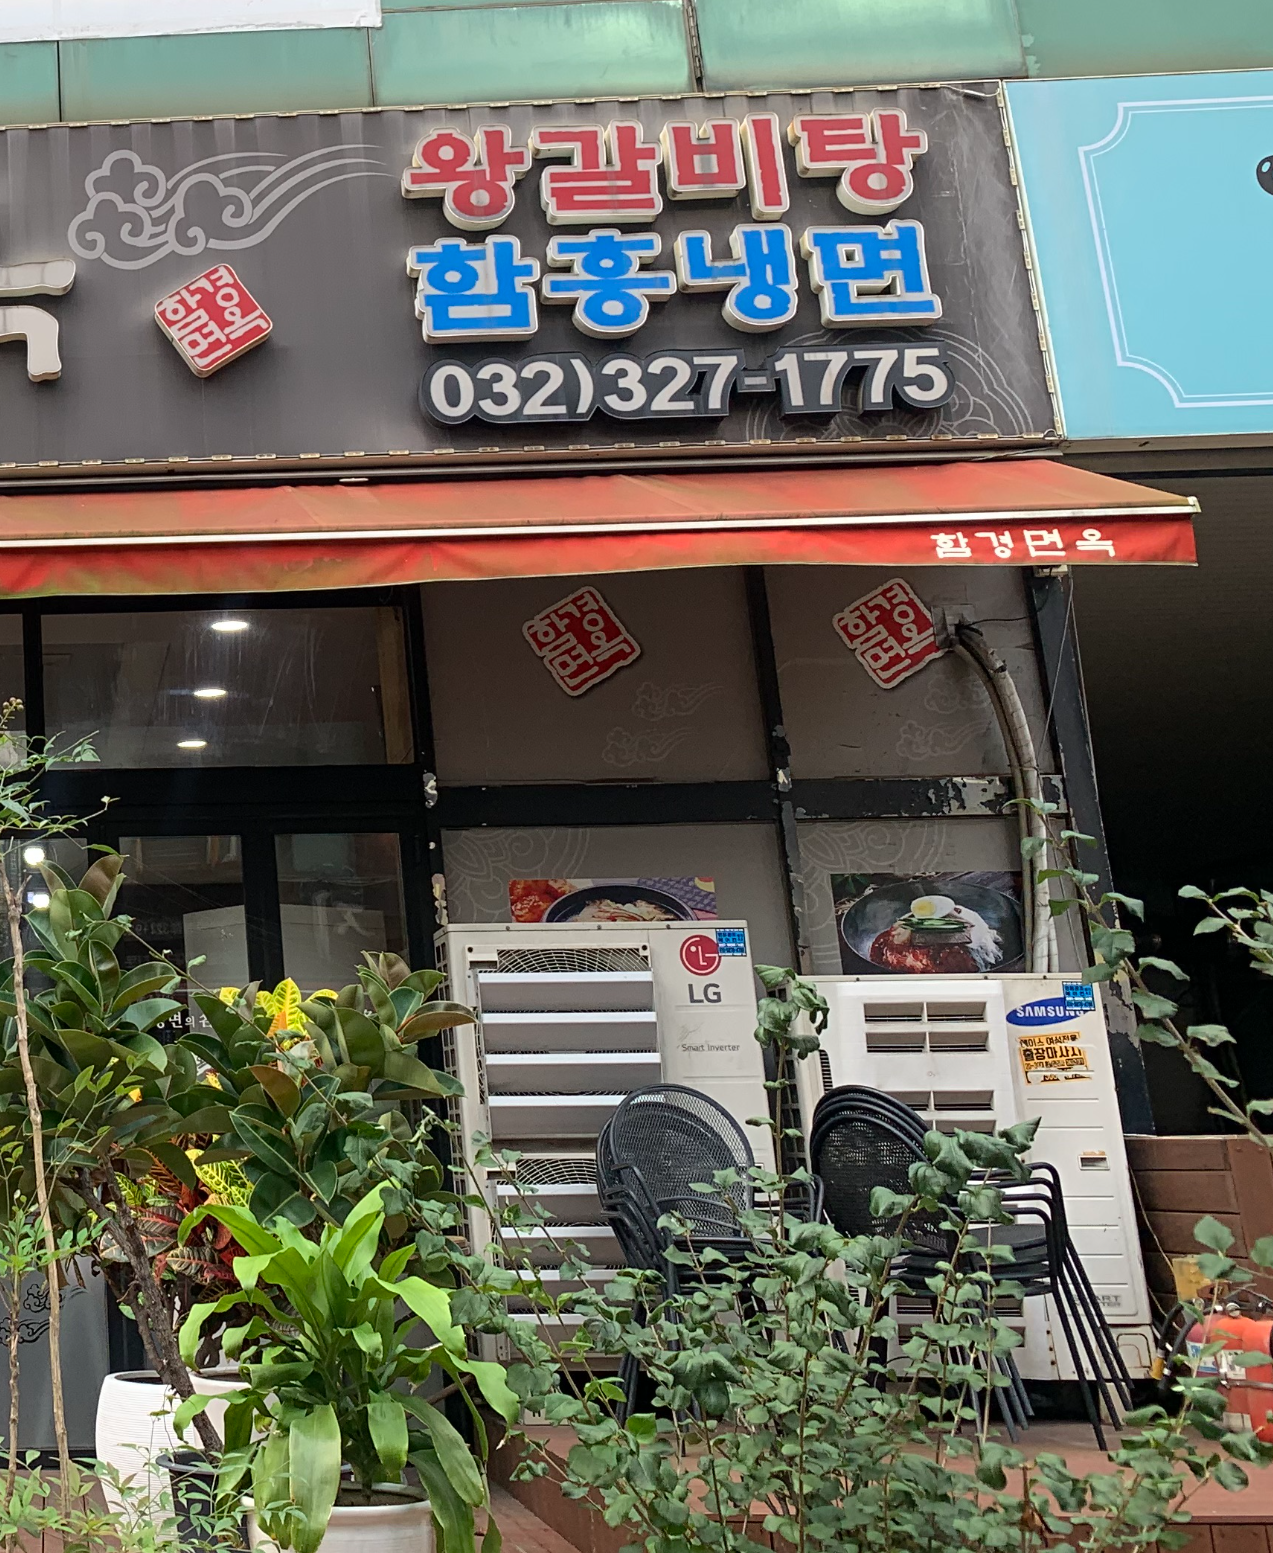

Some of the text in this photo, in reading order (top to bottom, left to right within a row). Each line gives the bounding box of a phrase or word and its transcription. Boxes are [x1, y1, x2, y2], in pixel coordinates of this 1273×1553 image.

[404, 107, 928, 230] 왕갈비탕
[407, 219, 941, 342] 함흥냉면
[429, 347, 951, 420] 032)327-1775
[930, 528, 1115, 558] 함경면옥
[688, 983, 722, 1003] LG
[681, 1043, 740, 1052] Smart Inverter
